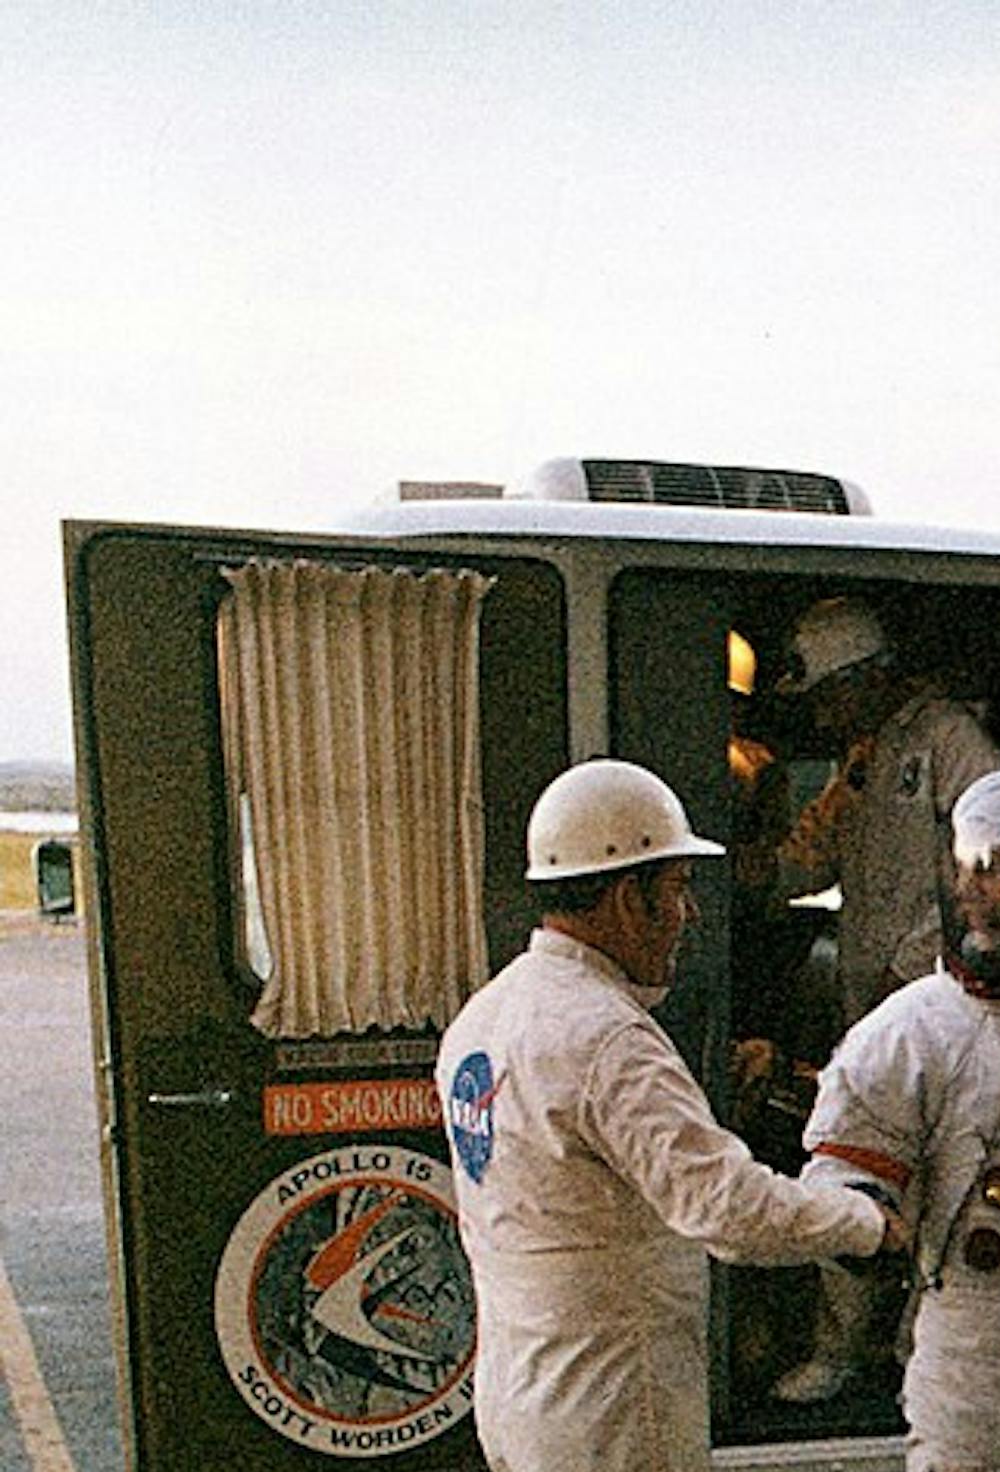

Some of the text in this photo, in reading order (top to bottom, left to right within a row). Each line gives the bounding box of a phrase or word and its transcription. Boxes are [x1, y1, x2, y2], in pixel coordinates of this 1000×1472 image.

[273, 1085, 443, 1127] NO SMOKING
[276, 1153, 433, 1204] APOLLO 15
[238, 1366, 453, 1449] SCOTT WORDEN
